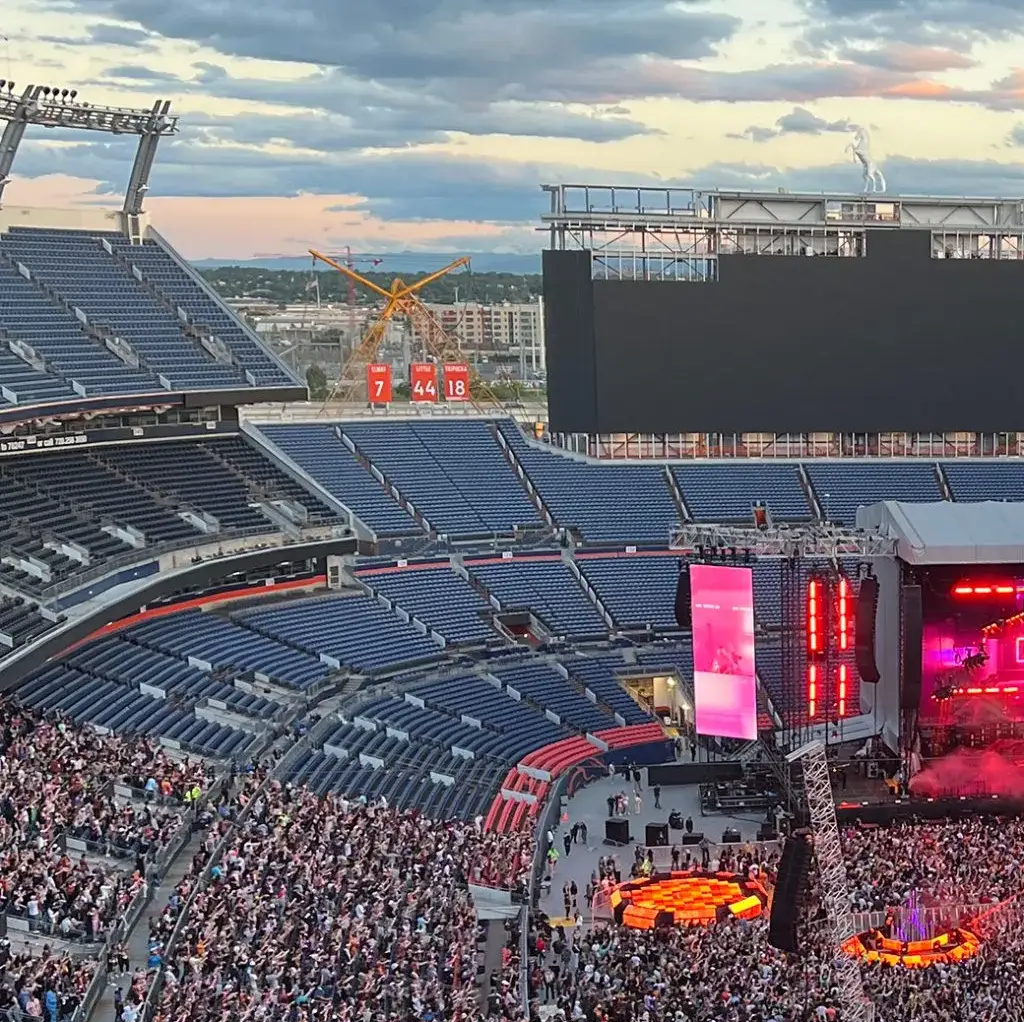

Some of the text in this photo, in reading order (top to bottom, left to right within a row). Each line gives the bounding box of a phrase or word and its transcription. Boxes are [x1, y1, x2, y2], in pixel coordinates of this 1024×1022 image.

[374, 381, 384, 396] 7
[414, 380, 436, 396] 44
[448, 380, 465, 396] 18
